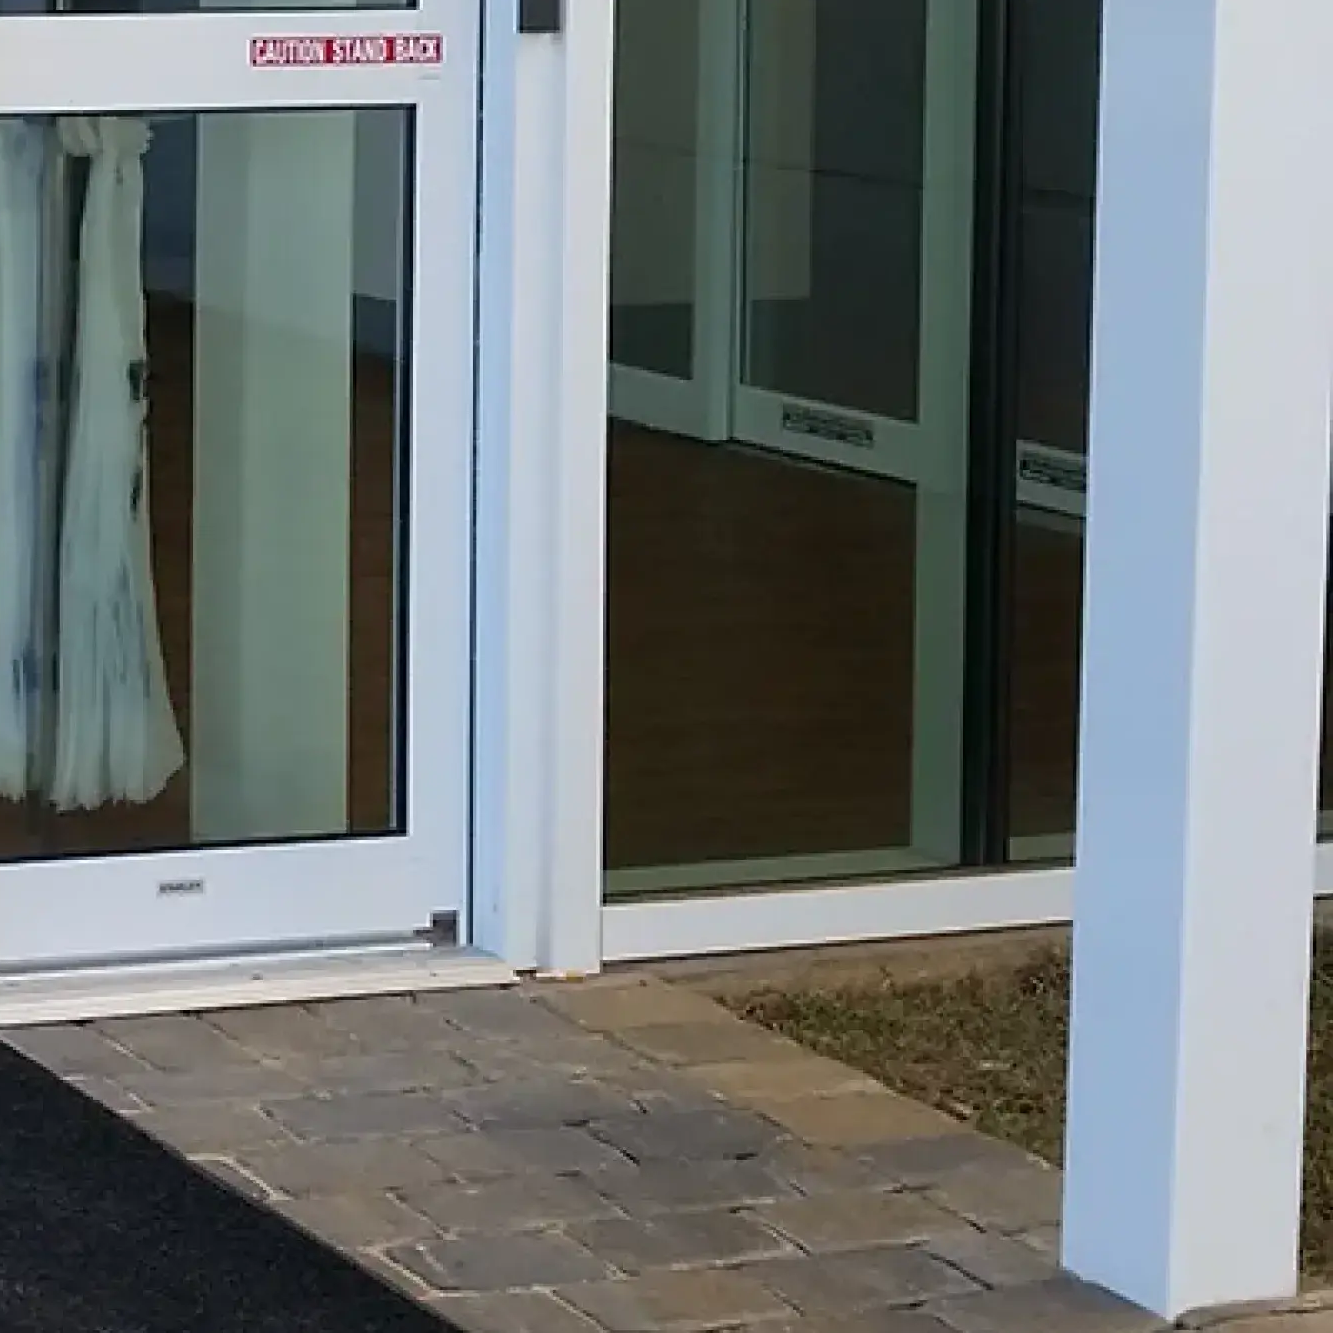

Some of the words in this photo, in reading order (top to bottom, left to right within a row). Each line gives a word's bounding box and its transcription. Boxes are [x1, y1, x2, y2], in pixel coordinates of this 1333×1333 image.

[255, 38, 325, 64] CAUTION
[332, 38, 385, 62] STAND
[395, 37, 439, 61] BACK
